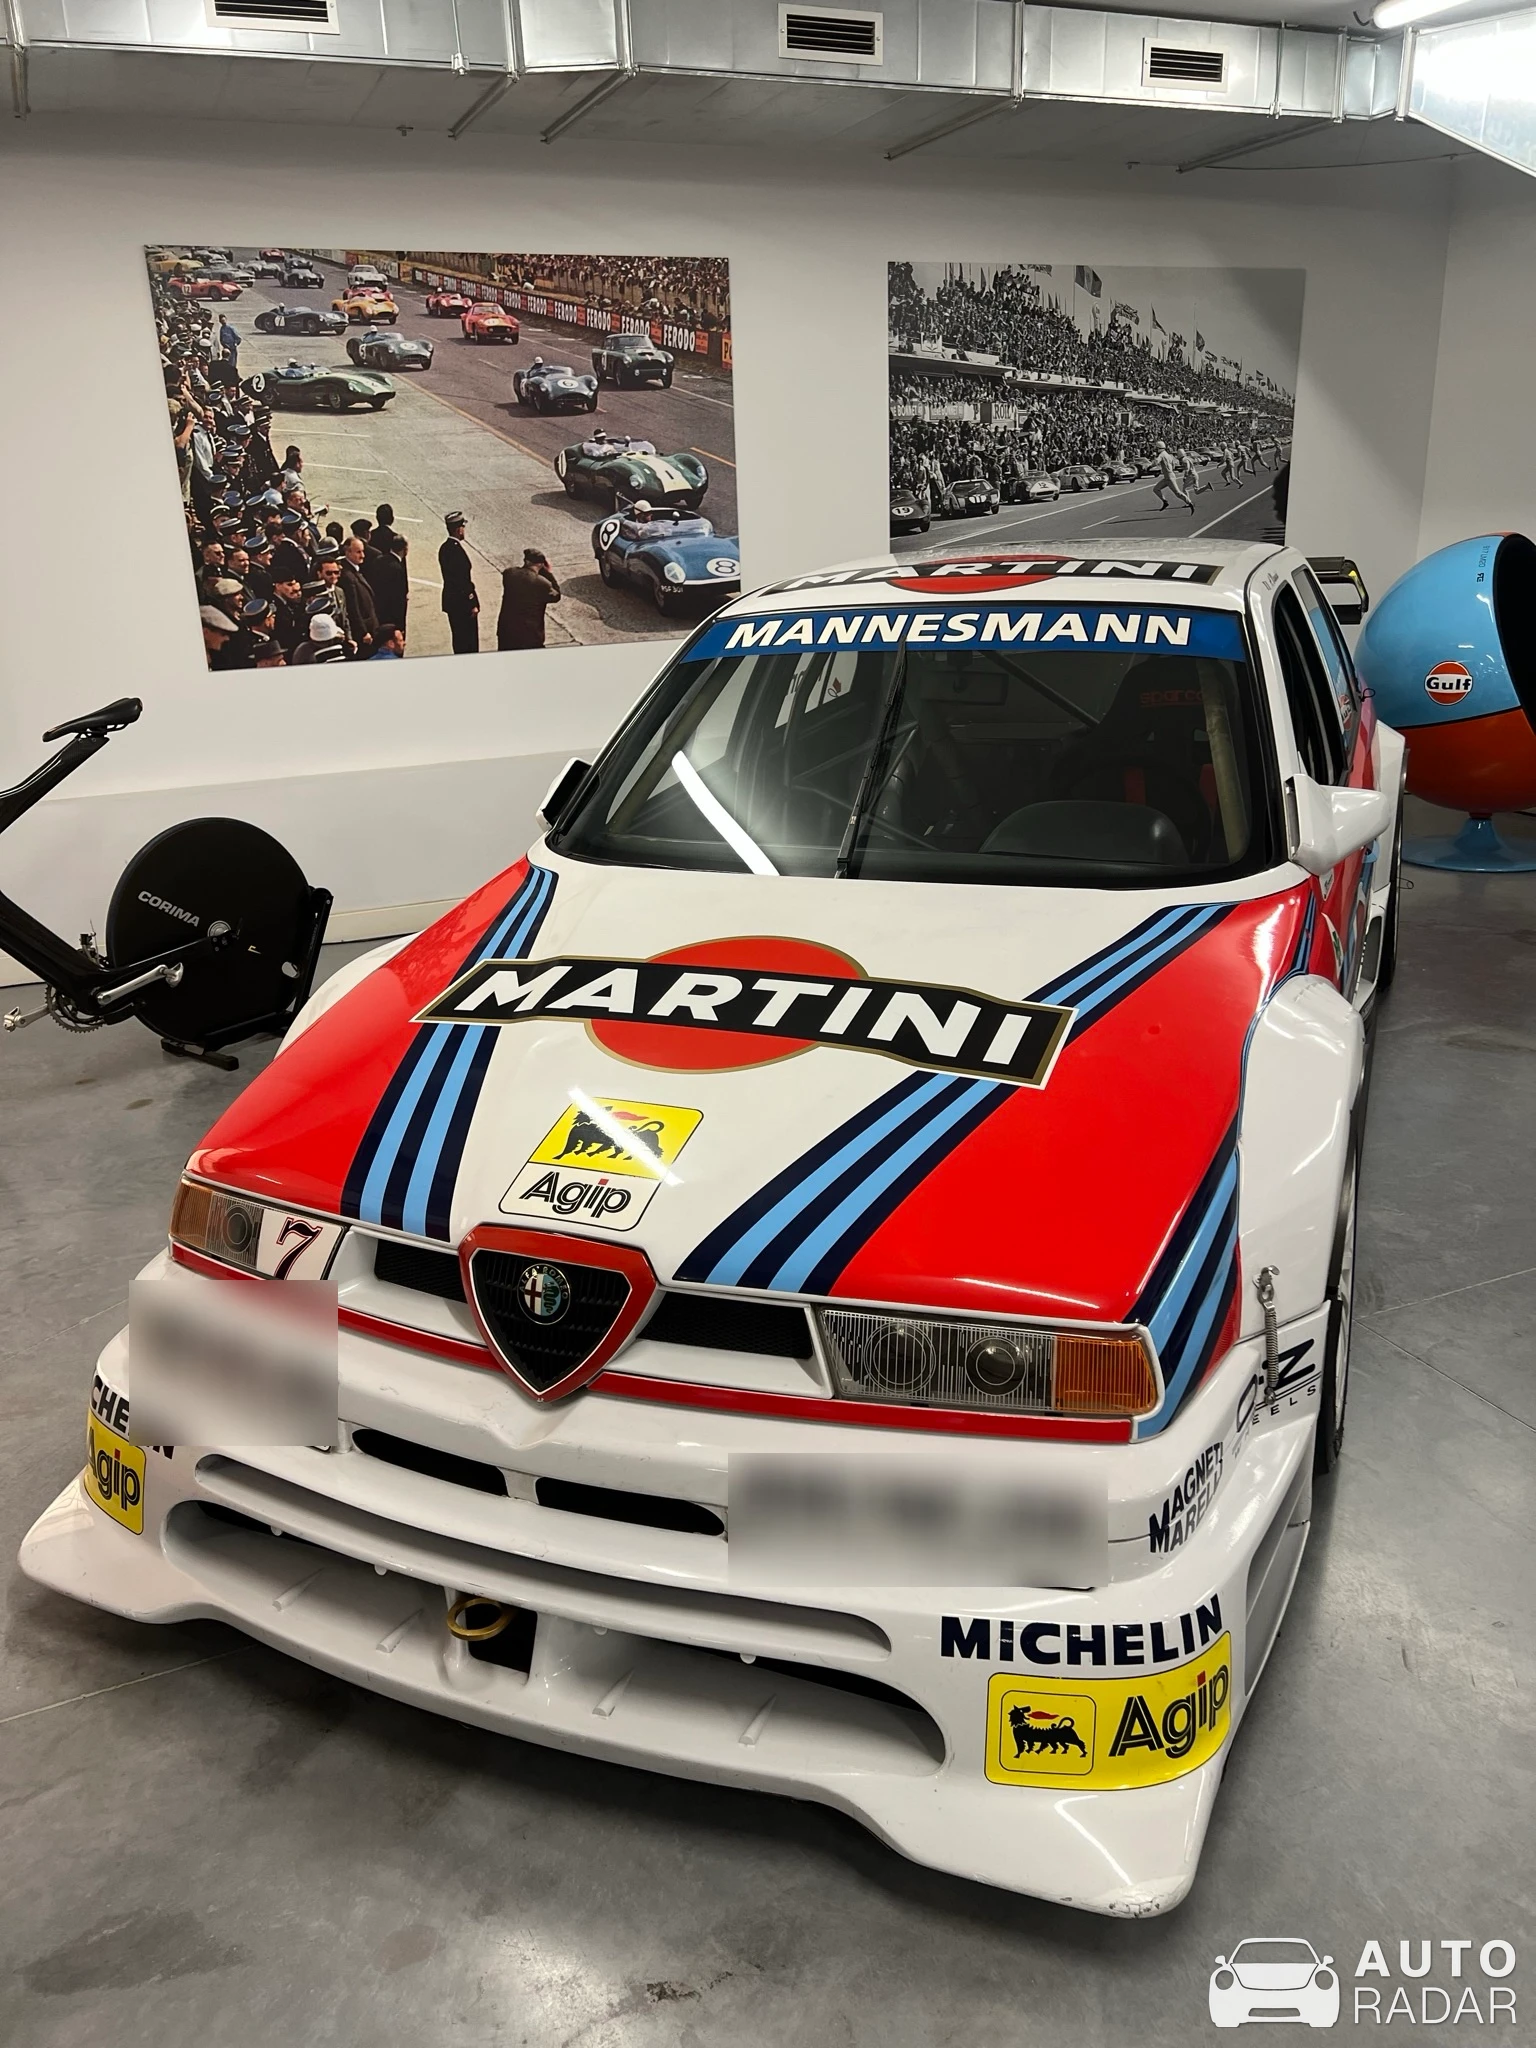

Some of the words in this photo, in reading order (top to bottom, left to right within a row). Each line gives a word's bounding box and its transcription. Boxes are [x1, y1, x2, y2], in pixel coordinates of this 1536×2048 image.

[503, 289, 521, 309] FERODO
[527, 296, 547, 316] FERODO
[554, 301, 578, 325] FERODO
[586, 307, 611, 332] FERODO
[621, 315, 650, 335] FERODO
[663, 324, 696, 352] FERODO
[255, 375, 264, 390] 2
[896, 507, 911, 516] 19
[601, 522, 617, 547] 8
[714, 560, 736, 575] 8
[784, 559, 1199, 589] MARTINI
[724, 612, 1192, 650] MANNESMANN
[1426, 677, 1472, 691] Gulf
[138, 890, 200, 927] CORIMA
[455, 964, 1032, 1065] MARTINI
[519, 1171, 632, 1219] Agip
[276, 1216, 324, 1280] 7
[518, 1267, 539, 1293] ALFA
[542, 1266, 569, 1300] ROMEO
[941, 1593, 1223, 1666] MICHELIN
[1108, 1664, 1229, 1760] Agip
